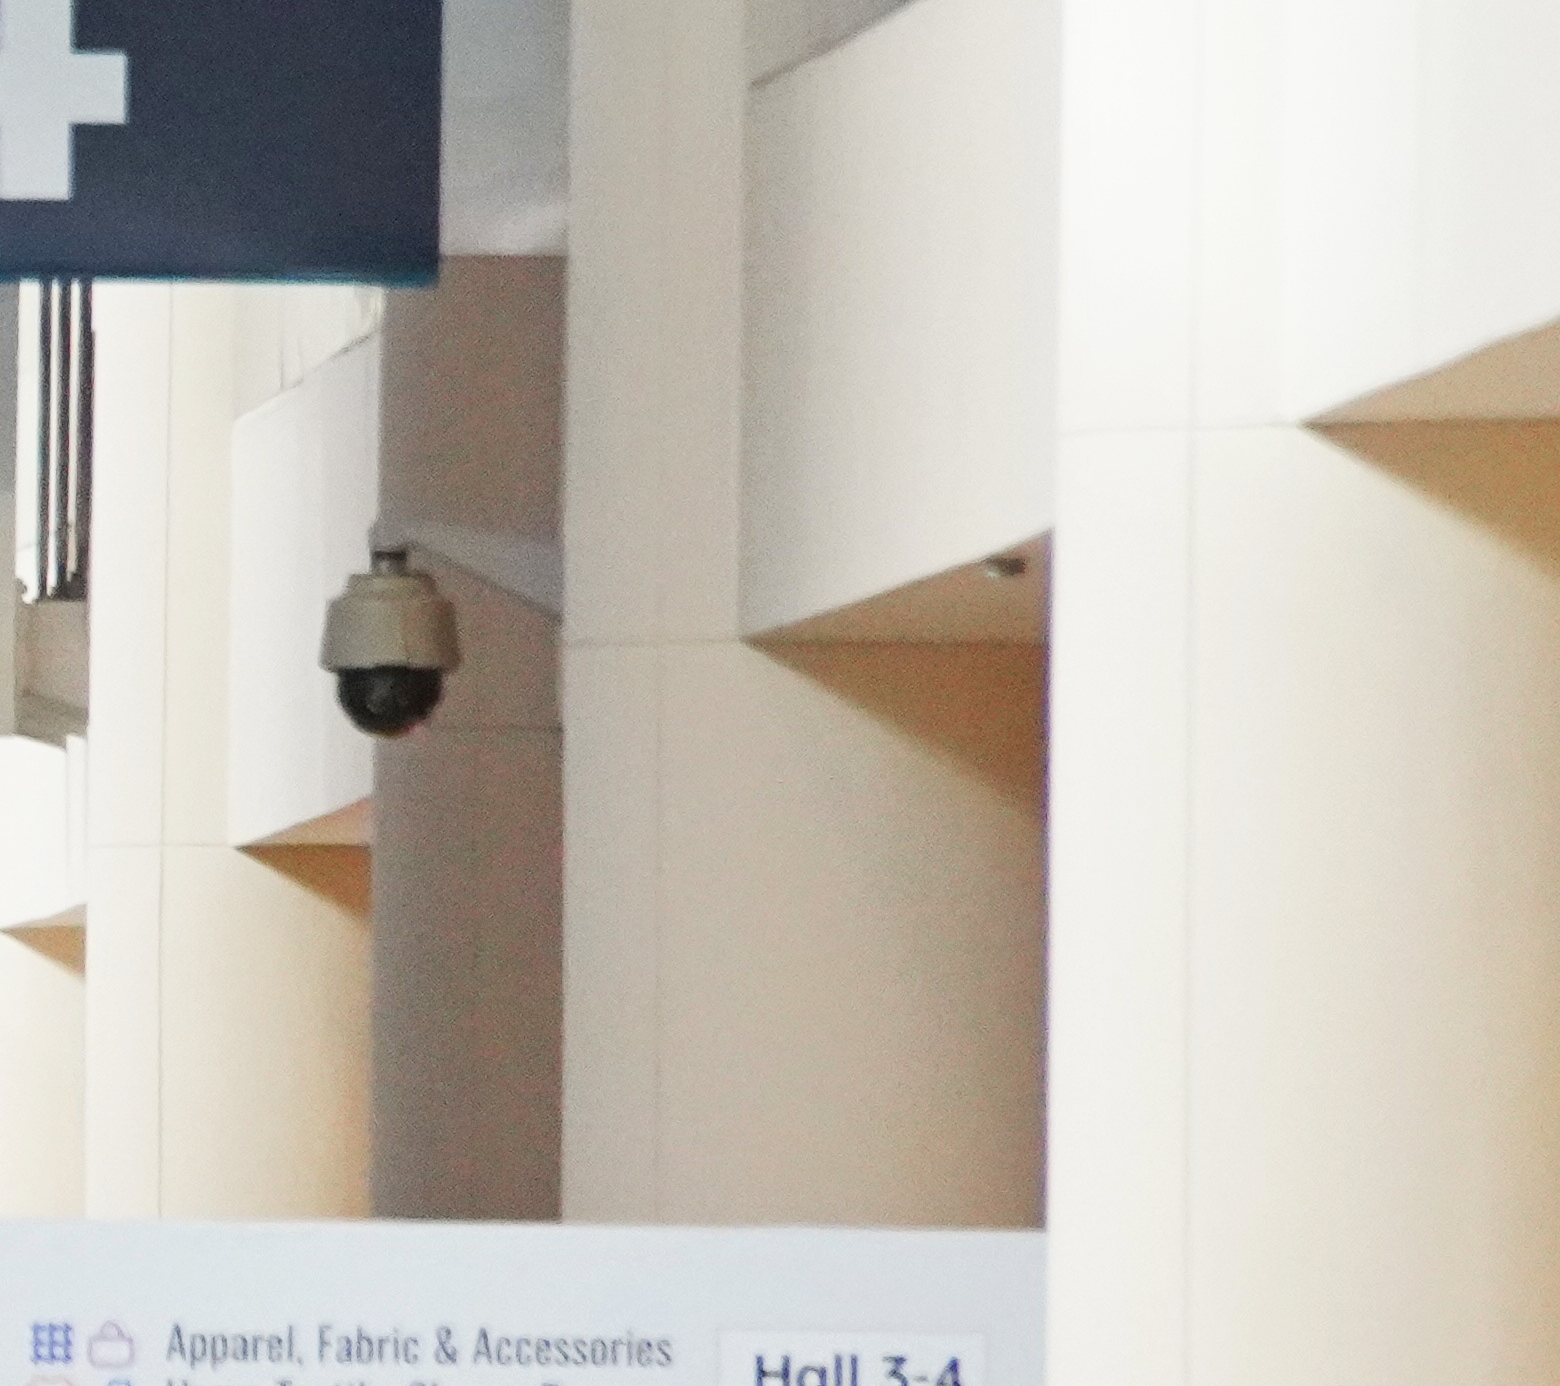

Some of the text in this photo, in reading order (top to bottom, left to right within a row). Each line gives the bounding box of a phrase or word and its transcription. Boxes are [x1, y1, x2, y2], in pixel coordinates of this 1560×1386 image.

[166, 1322, 674, 1370] Apparel, Fabric & Accessories
